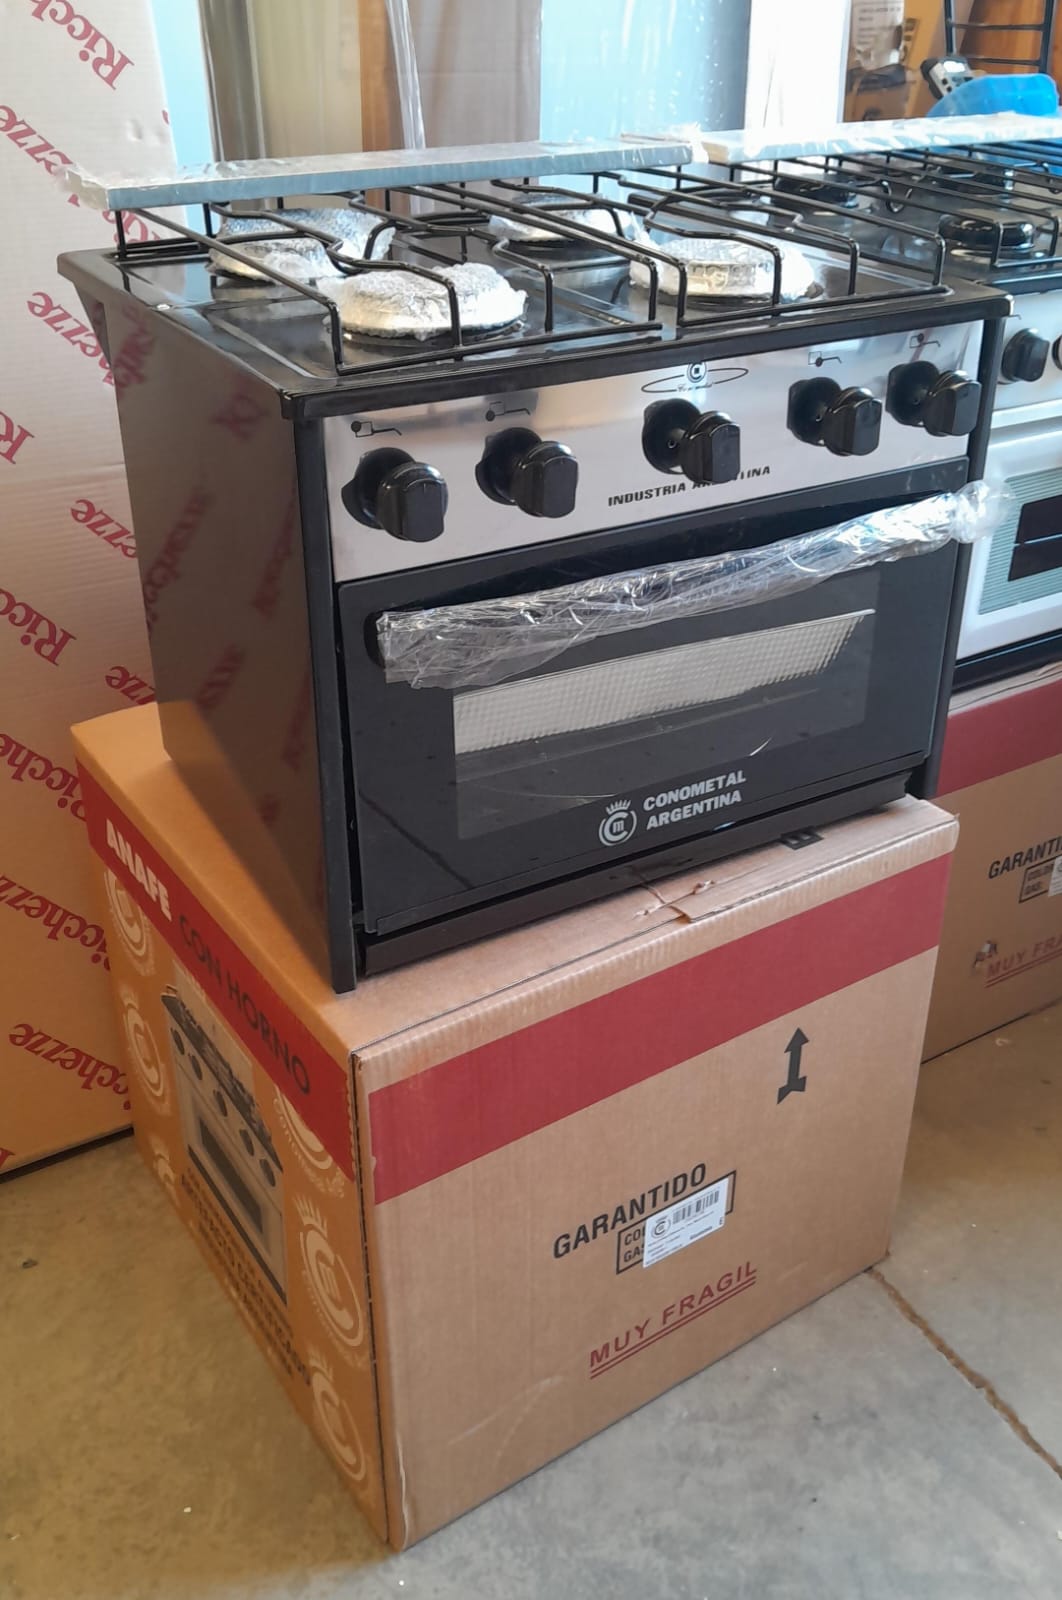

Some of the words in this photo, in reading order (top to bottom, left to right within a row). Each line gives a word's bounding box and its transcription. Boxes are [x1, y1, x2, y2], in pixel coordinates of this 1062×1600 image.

[607, 482, 687, 507] INDUSTRIA
[643, 770, 747, 812] CONOMETAL
[646, 789, 743, 831] ARGENTINA
[988, 835, 1062, 879] GARANTI
[107, 818, 172, 922] ANAFE
[179, 914, 222, 986] CON
[226, 974, 310, 1095] HORNO
[986, 951, 1025, 979] MUY
[554, 1162, 707, 1260] GARANTIDO
[590, 1317, 651, 1368] MUY
[662, 1261, 758, 1325] FRAGIL
